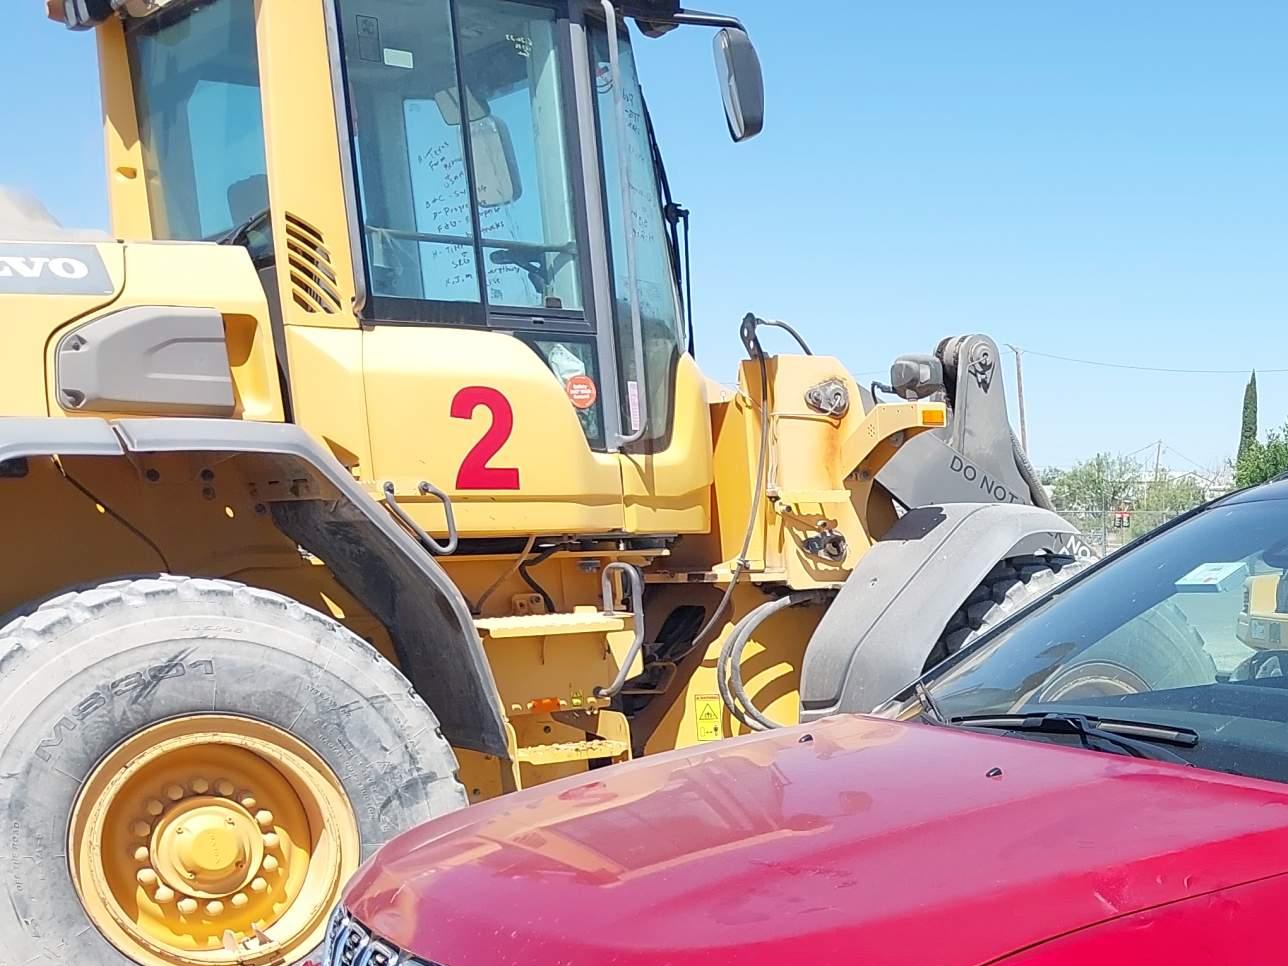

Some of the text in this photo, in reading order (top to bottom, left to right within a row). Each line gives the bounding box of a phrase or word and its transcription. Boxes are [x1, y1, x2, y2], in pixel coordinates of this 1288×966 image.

[450, 386, 520, 490] 2
[950, 455, 1018, 503] DO NOT
